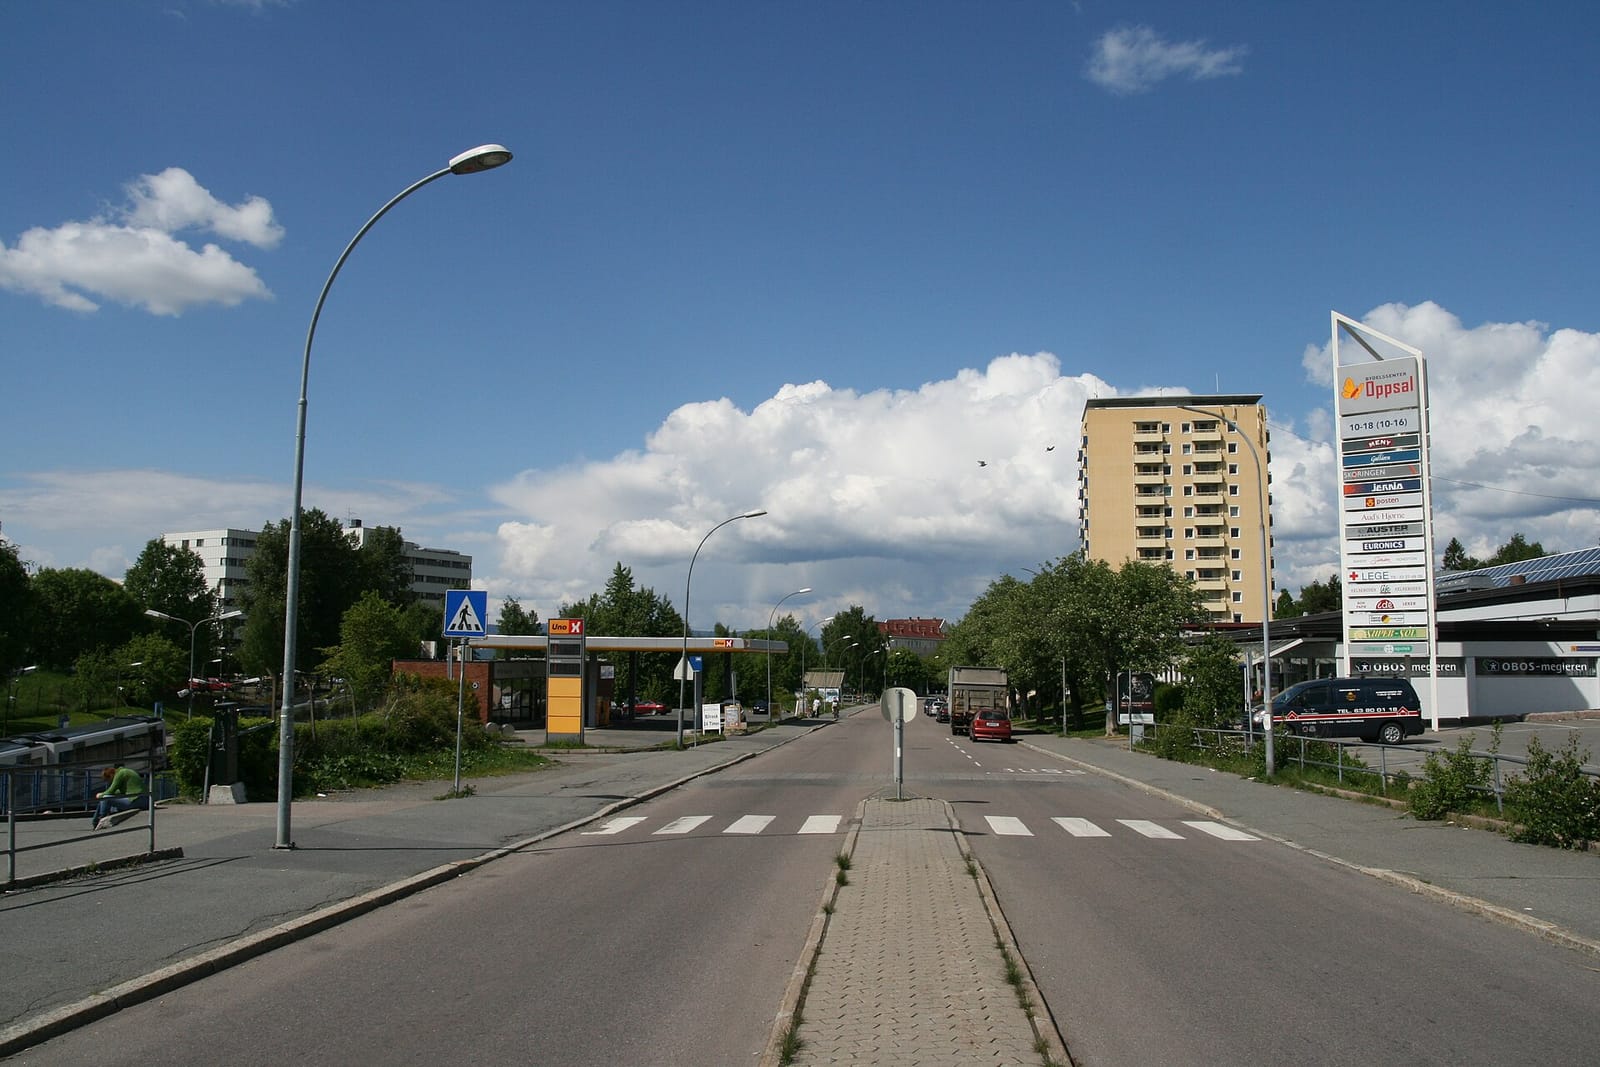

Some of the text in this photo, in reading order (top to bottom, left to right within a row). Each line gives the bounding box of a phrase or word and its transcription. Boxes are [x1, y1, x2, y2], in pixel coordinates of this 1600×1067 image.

[1366, 376, 1413, 398] Oppsal
[1349, 418, 1408, 431] 10-18 (10-16)
[1344, 469, 1386, 479] SKORINGEN
[1376, 497, 1400, 505] posten
[1366, 525, 1408, 533] AUSTER
[1363, 541, 1404, 550] EURONICS
[1361, 571, 1390, 581] LEGE
[571, 621, 581, 633] X
[1502, 662, 1588, 674] OBOS-megleren
